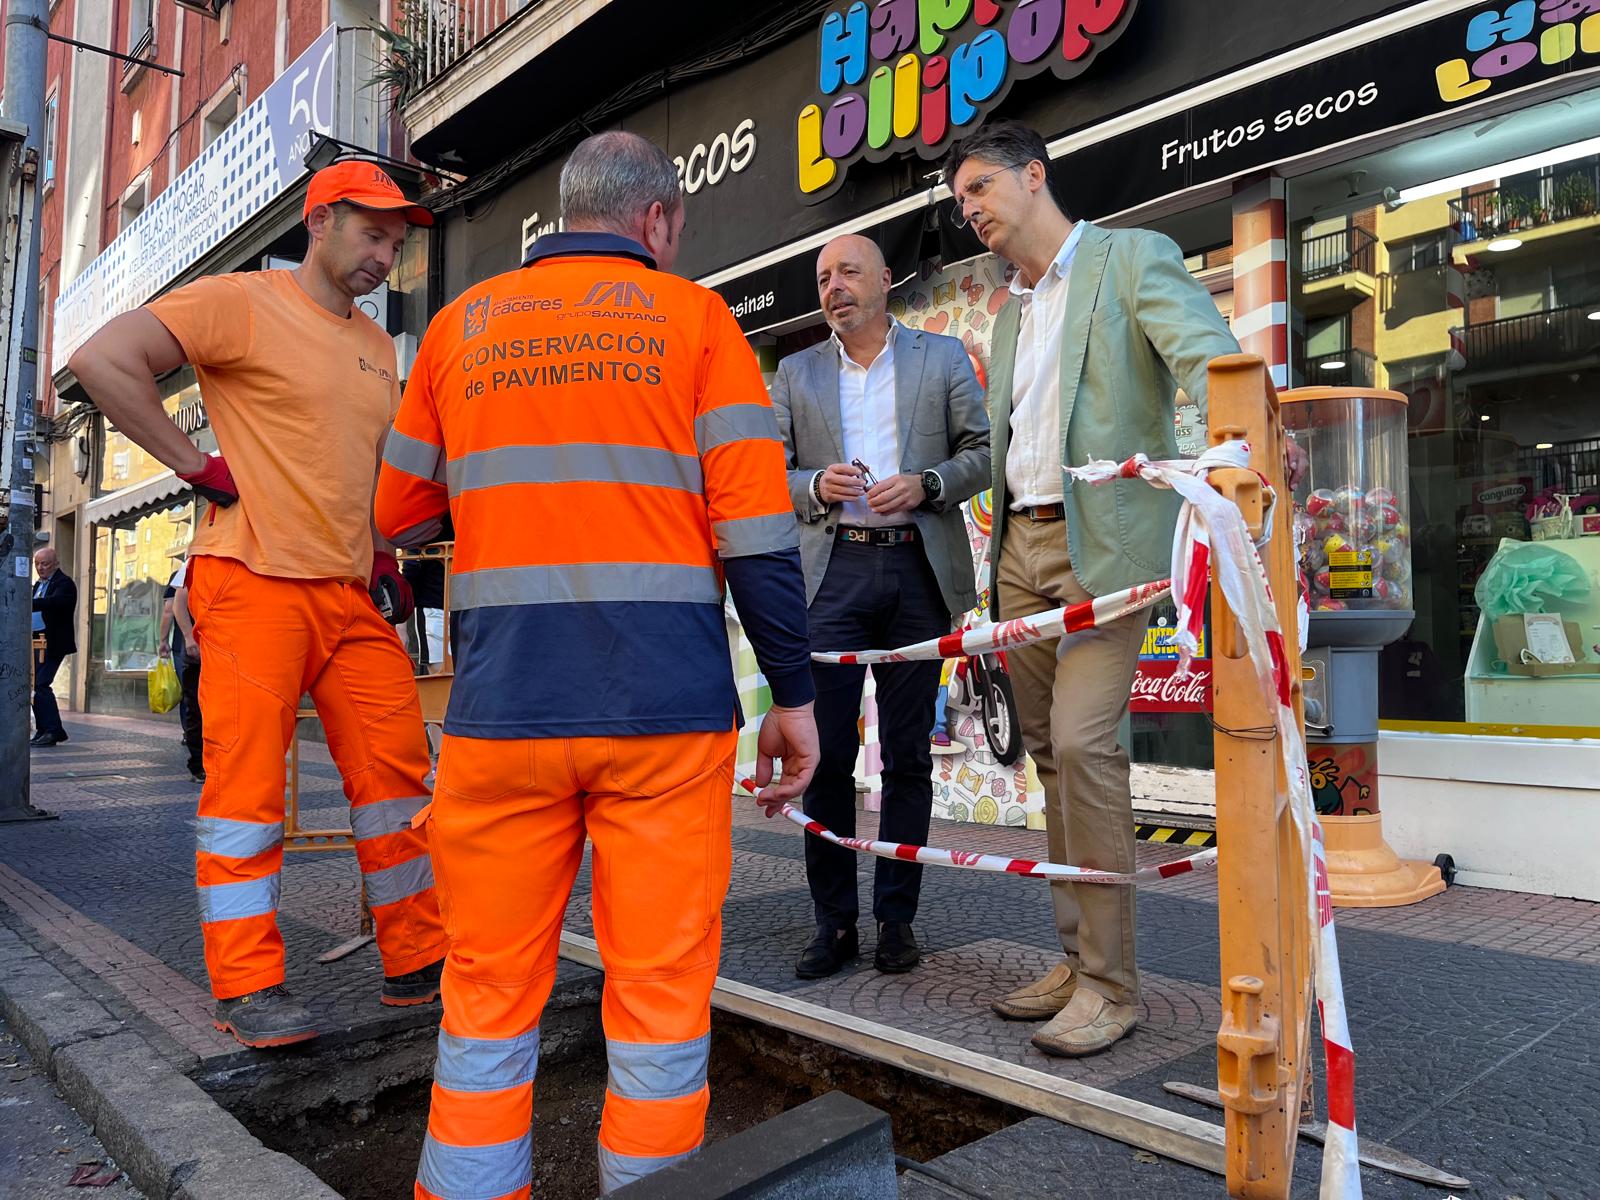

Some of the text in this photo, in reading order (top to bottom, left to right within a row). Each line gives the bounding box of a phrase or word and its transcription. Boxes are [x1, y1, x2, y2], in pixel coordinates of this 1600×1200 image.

[1161, 80, 1378, 170] Frutos secos
[288, 131, 311, 165] AÑO
[675, 118, 756, 194] ecos
[140, 172, 205, 250] TELAS Y HOGAR
[158, 223, 176, 250] MODA
[183, 185, 218, 224] ARREGLOS
[728, 291, 775, 319] osinas
[462, 331, 666, 373] CONSERVACIÓN
[465, 360, 662, 401] de PAVIMENTOS
[1130, 669, 1211, 702] oca-Cola
